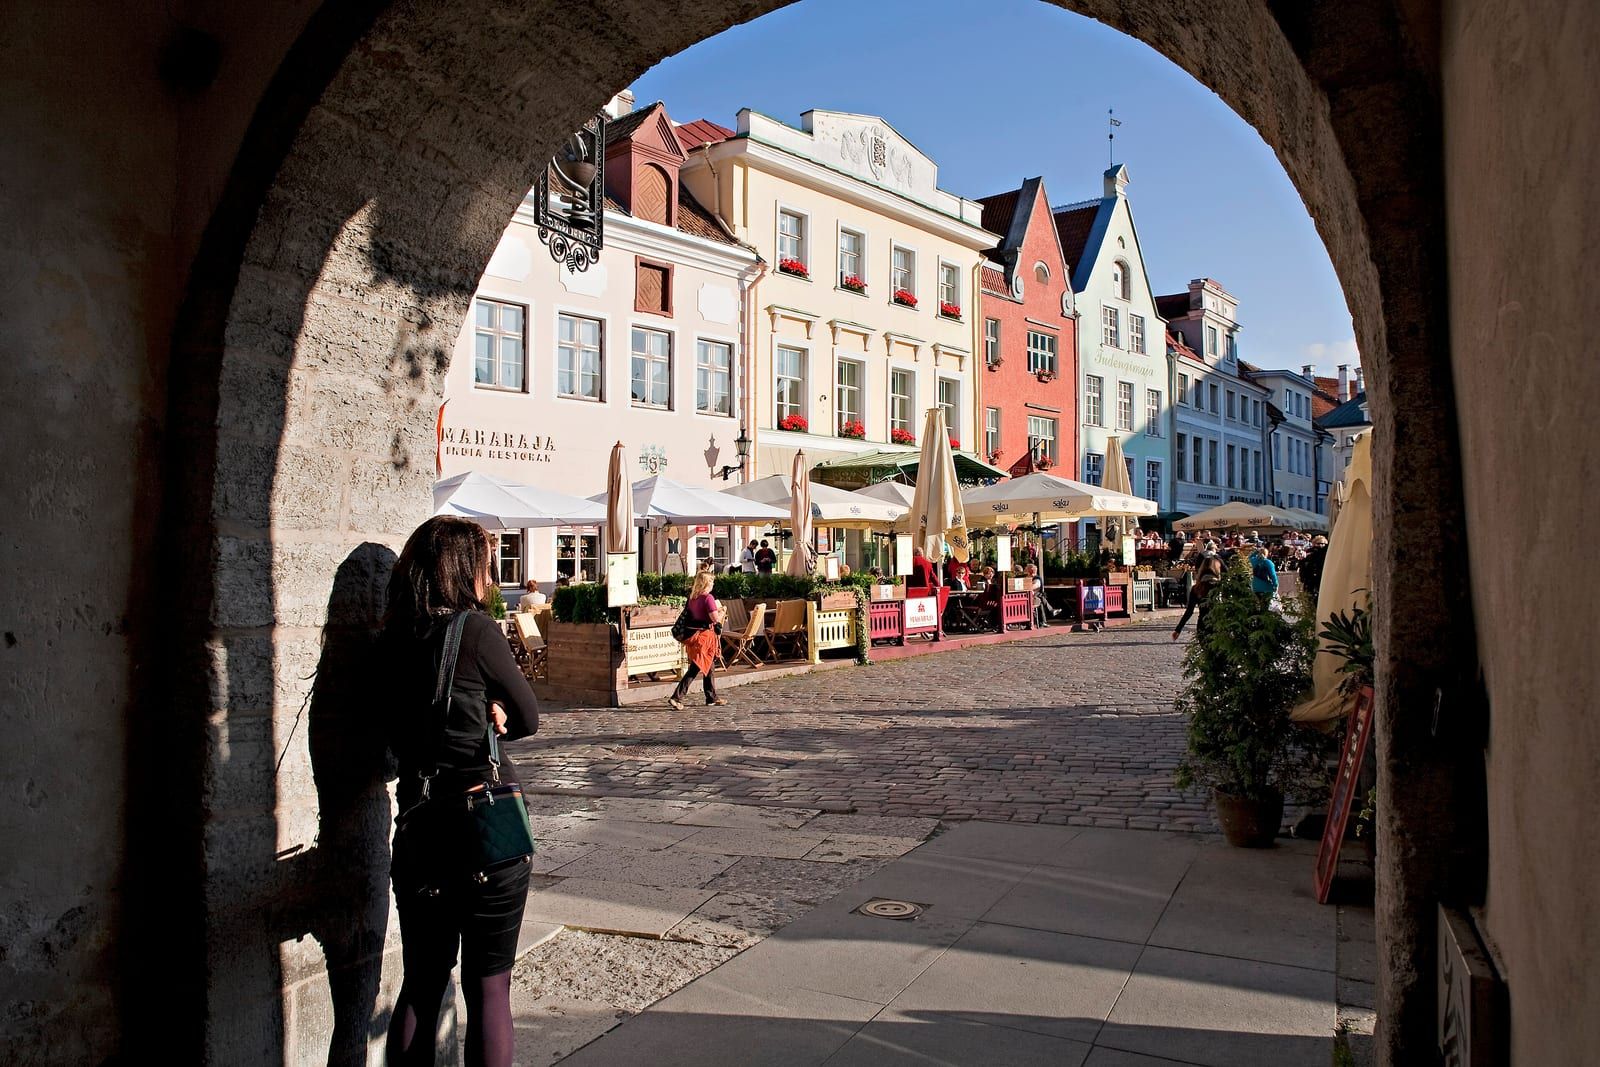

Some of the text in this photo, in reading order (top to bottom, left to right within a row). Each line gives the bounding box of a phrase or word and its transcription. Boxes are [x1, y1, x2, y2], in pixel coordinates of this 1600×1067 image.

[441, 427, 556, 451] MAHARAJA
[446, 446, 551, 463] INDIA RESTORAN
